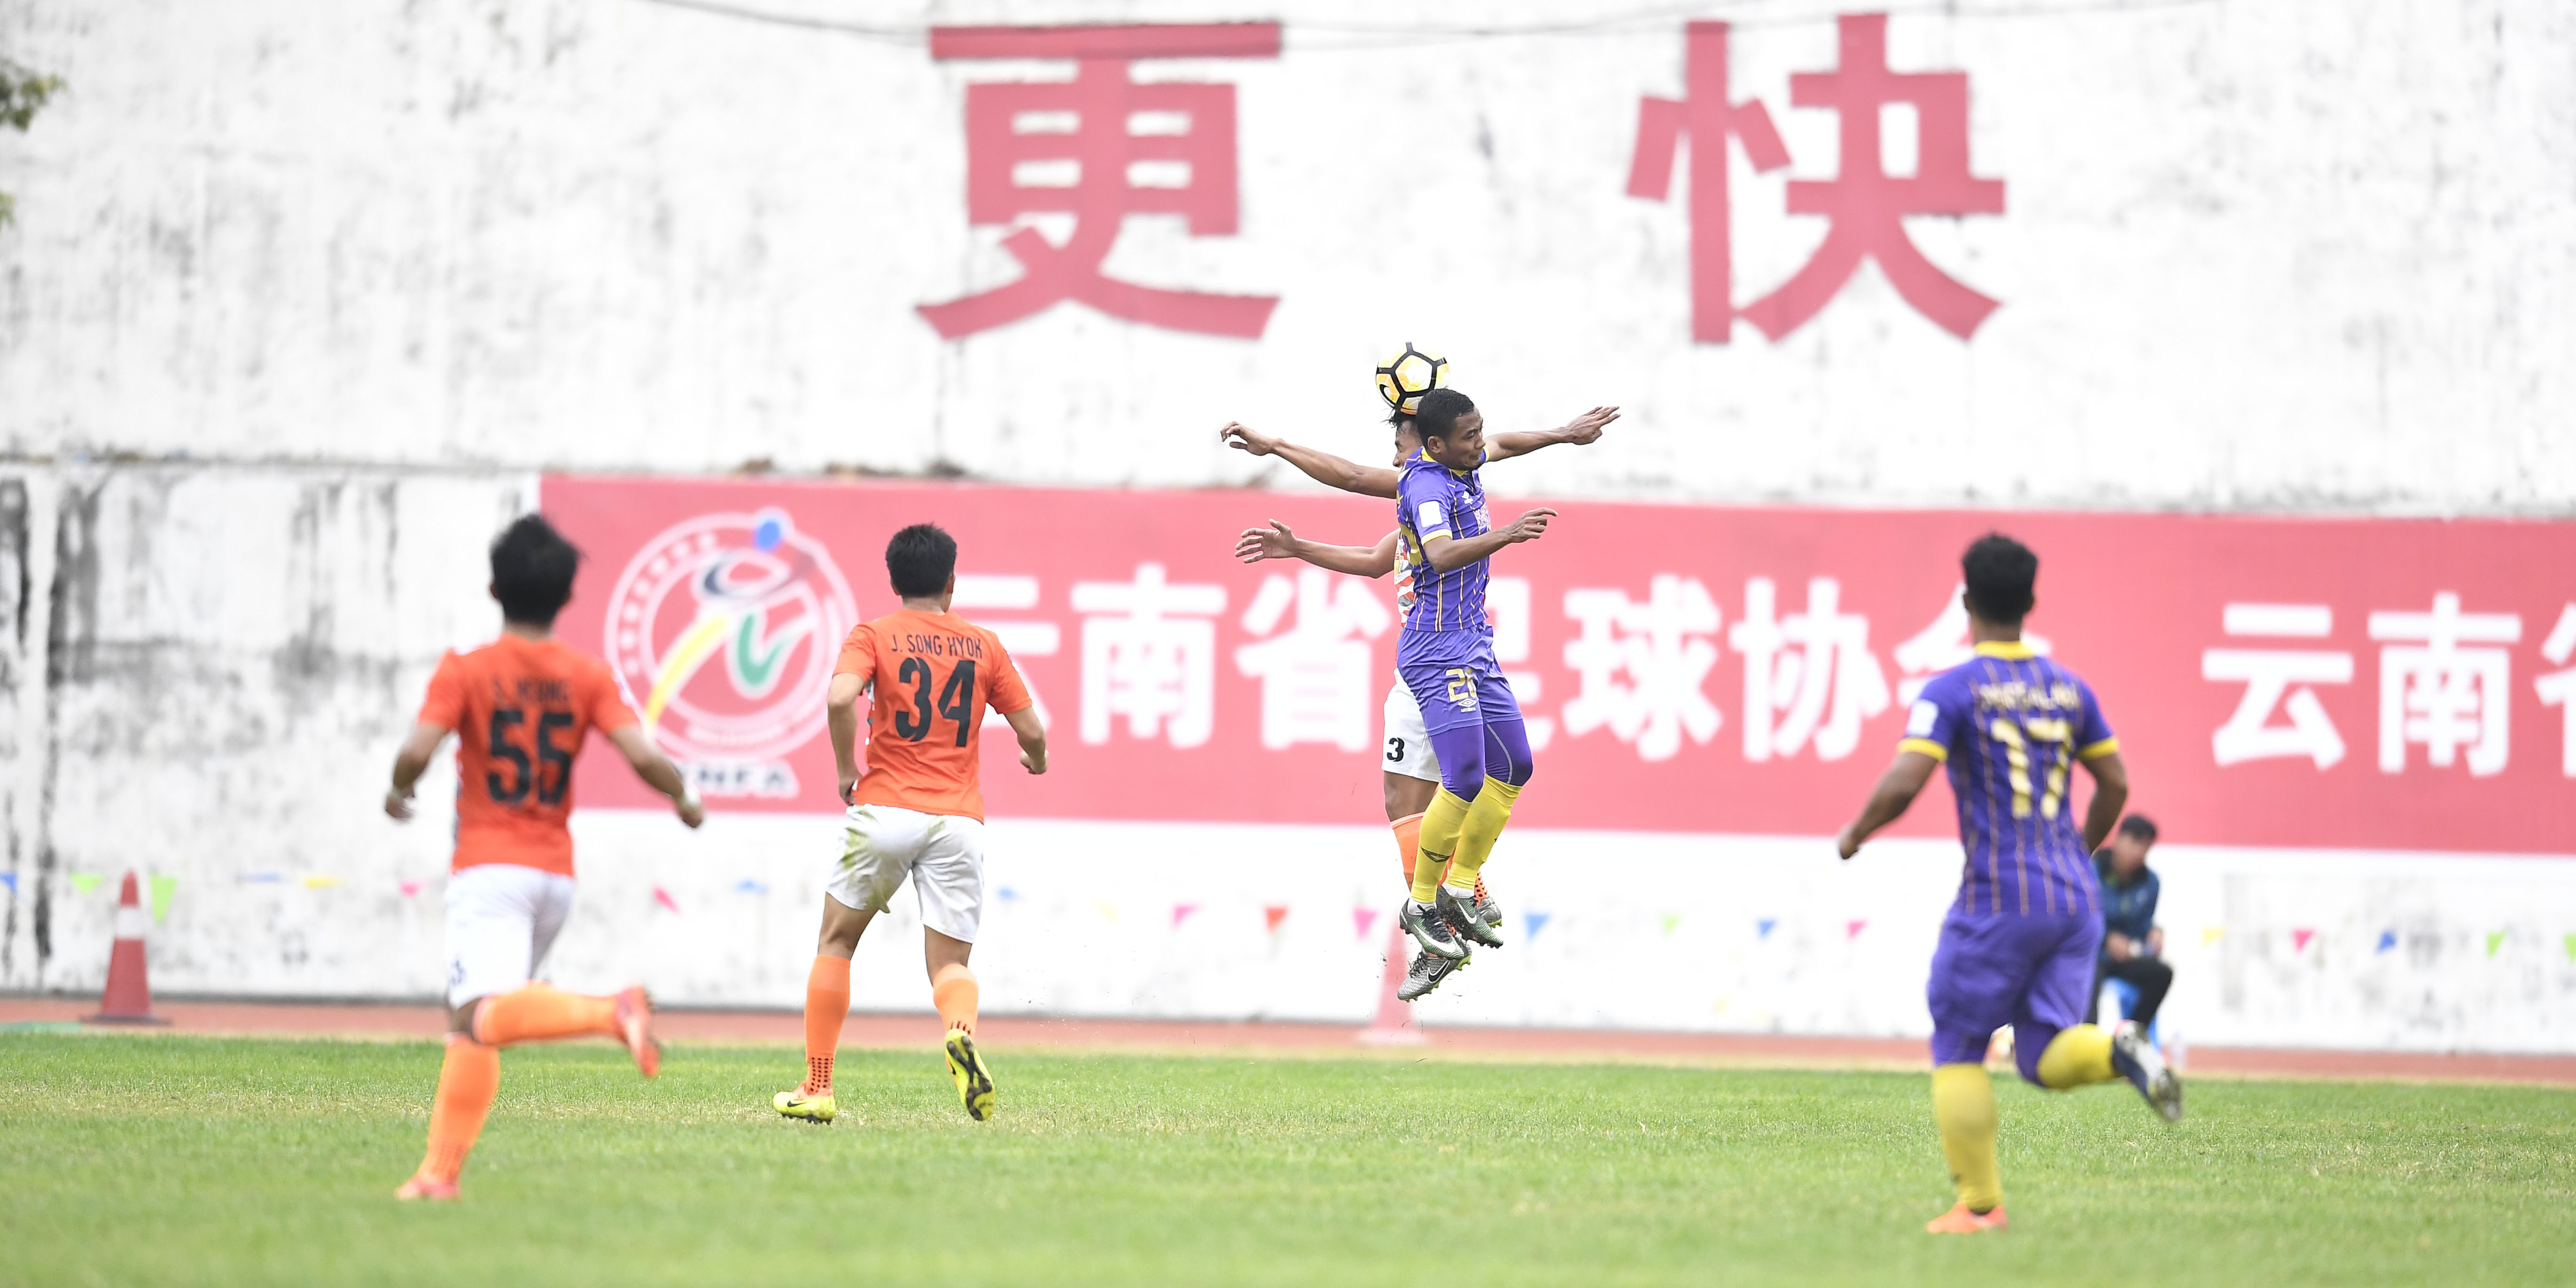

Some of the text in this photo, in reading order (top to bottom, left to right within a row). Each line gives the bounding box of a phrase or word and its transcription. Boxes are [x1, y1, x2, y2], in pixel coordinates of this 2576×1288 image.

[915, 13, 2005, 345] 更快
[892, 634, 982, 659] J. SONG HYOK
[2201, 590, 2576, 777] 云南
[895, 656, 975, 747] 34
[487, 709, 574, 804] 55
[681, 766, 789, 786] NFA
[1386, 737, 1405, 762] 3
[1989, 717, 2072, 820] 17
